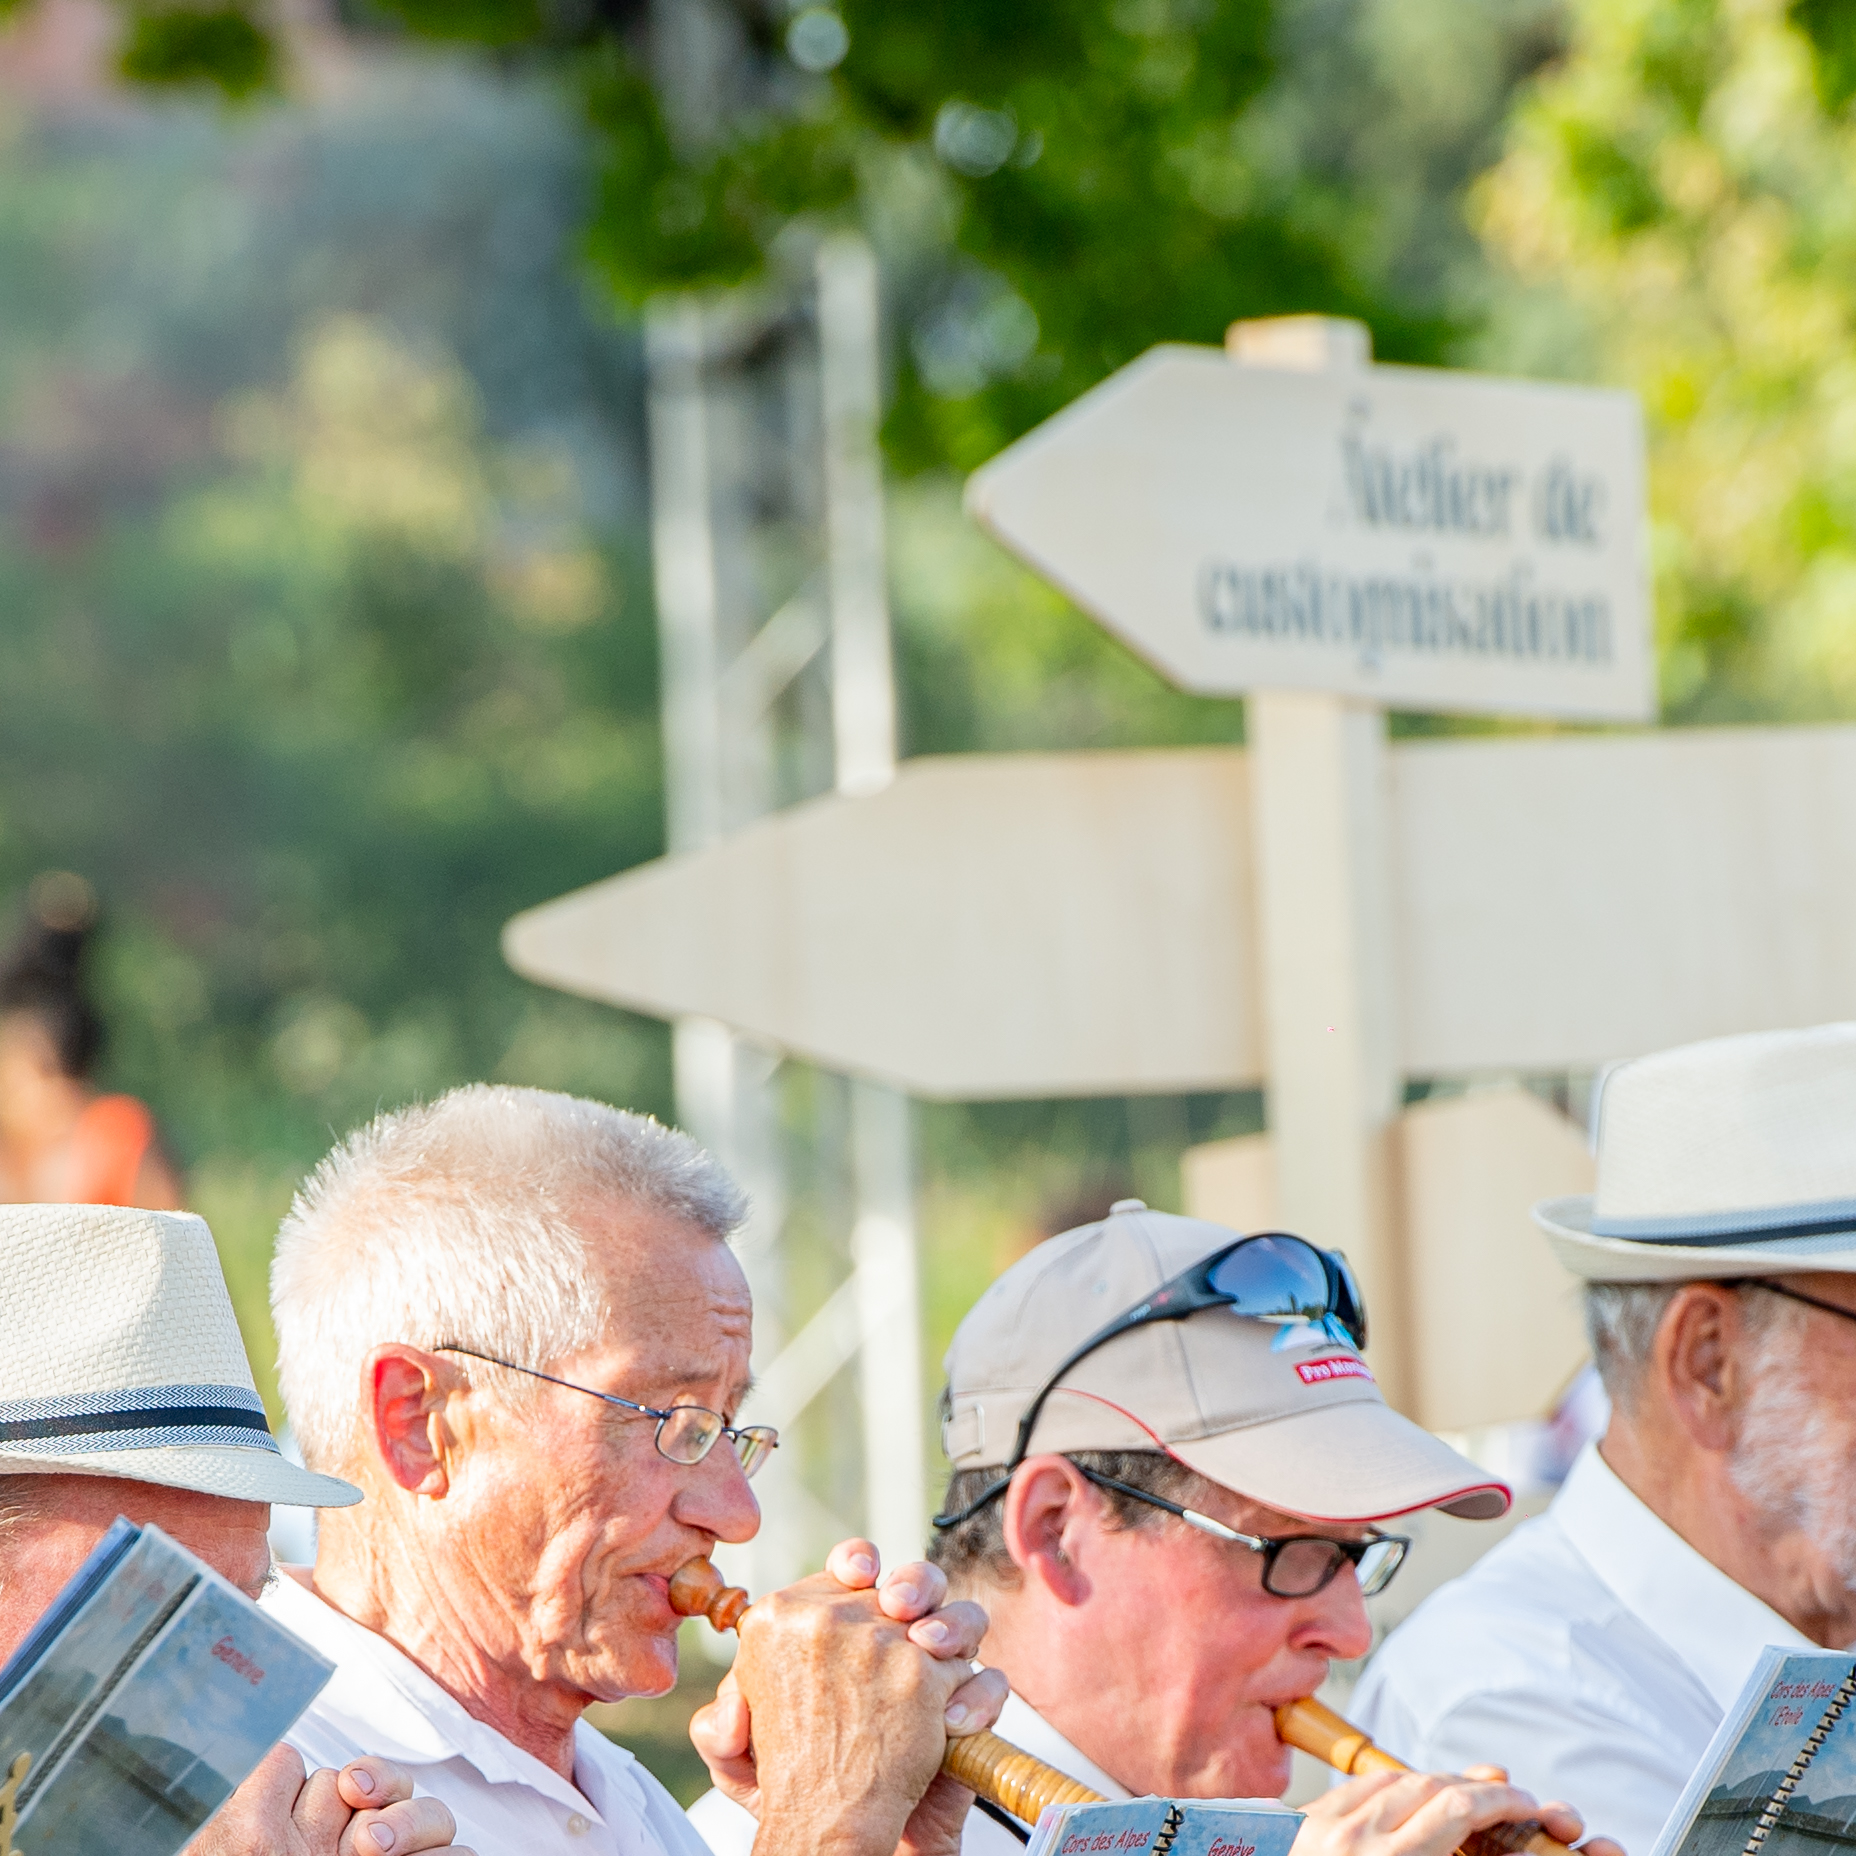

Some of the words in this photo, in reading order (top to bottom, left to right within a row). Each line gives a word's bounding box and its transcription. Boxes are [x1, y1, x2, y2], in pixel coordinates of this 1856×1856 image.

[1532, 450, 1608, 543] de
[1197, 552, 1616, 676] customisation
[1300, 1363, 1332, 1382] Pro
[1062, 1833, 1091, 1855] Cors
[1092, 1829, 1115, 1851] des
[1114, 1826, 1152, 1855] Alpes
